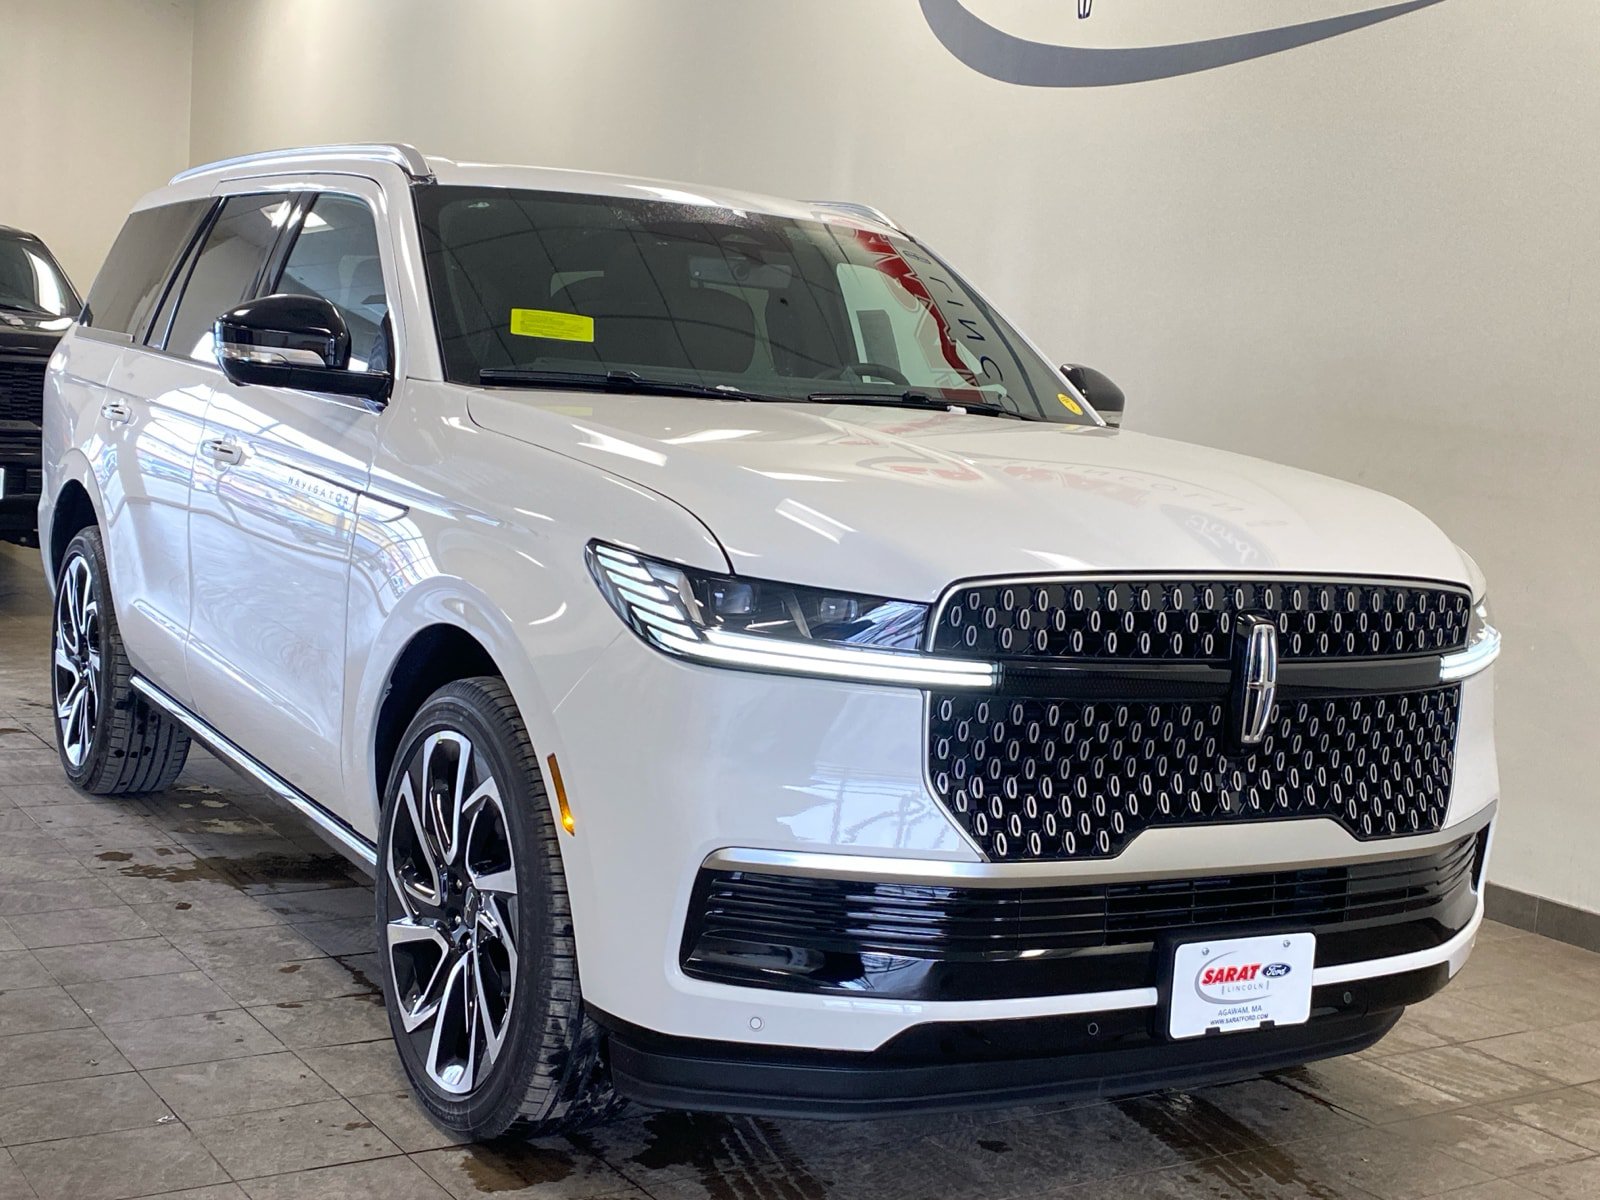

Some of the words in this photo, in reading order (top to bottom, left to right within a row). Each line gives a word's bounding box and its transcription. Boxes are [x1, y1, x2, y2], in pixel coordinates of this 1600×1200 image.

[287, 476, 349, 506] NAVIGATOR
[1201, 964, 1261, 985] SARAT
[1265, 964, 1287, 977] Ford
[1227, 983, 1264, 993] LINCOLN
[1251, 1005, 1263, 1014] MA
